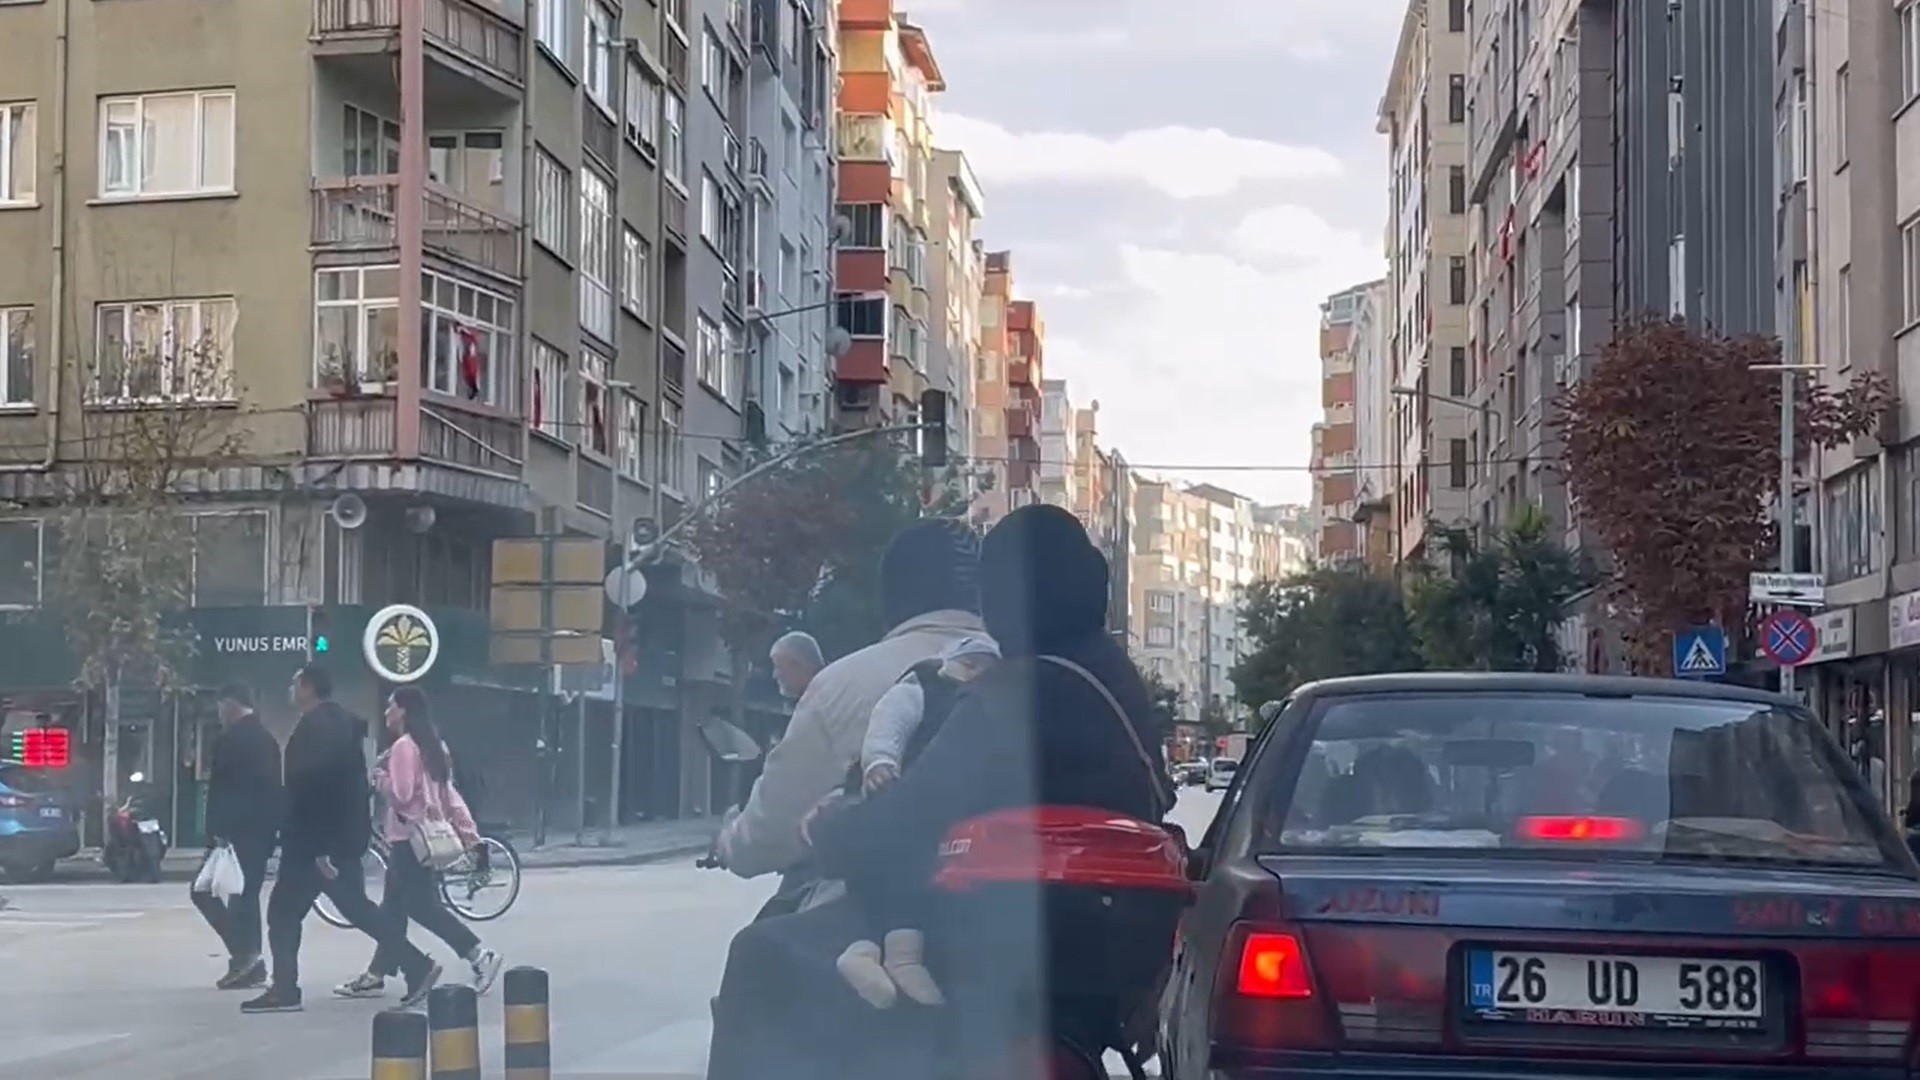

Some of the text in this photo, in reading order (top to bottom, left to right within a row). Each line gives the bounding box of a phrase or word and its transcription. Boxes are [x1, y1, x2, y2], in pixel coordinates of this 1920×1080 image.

[214, 636, 310, 652] YUNUS EMR
[1474, 983, 1492, 998] TR
[1497, 956, 1757, 1011] 26 UD 588
